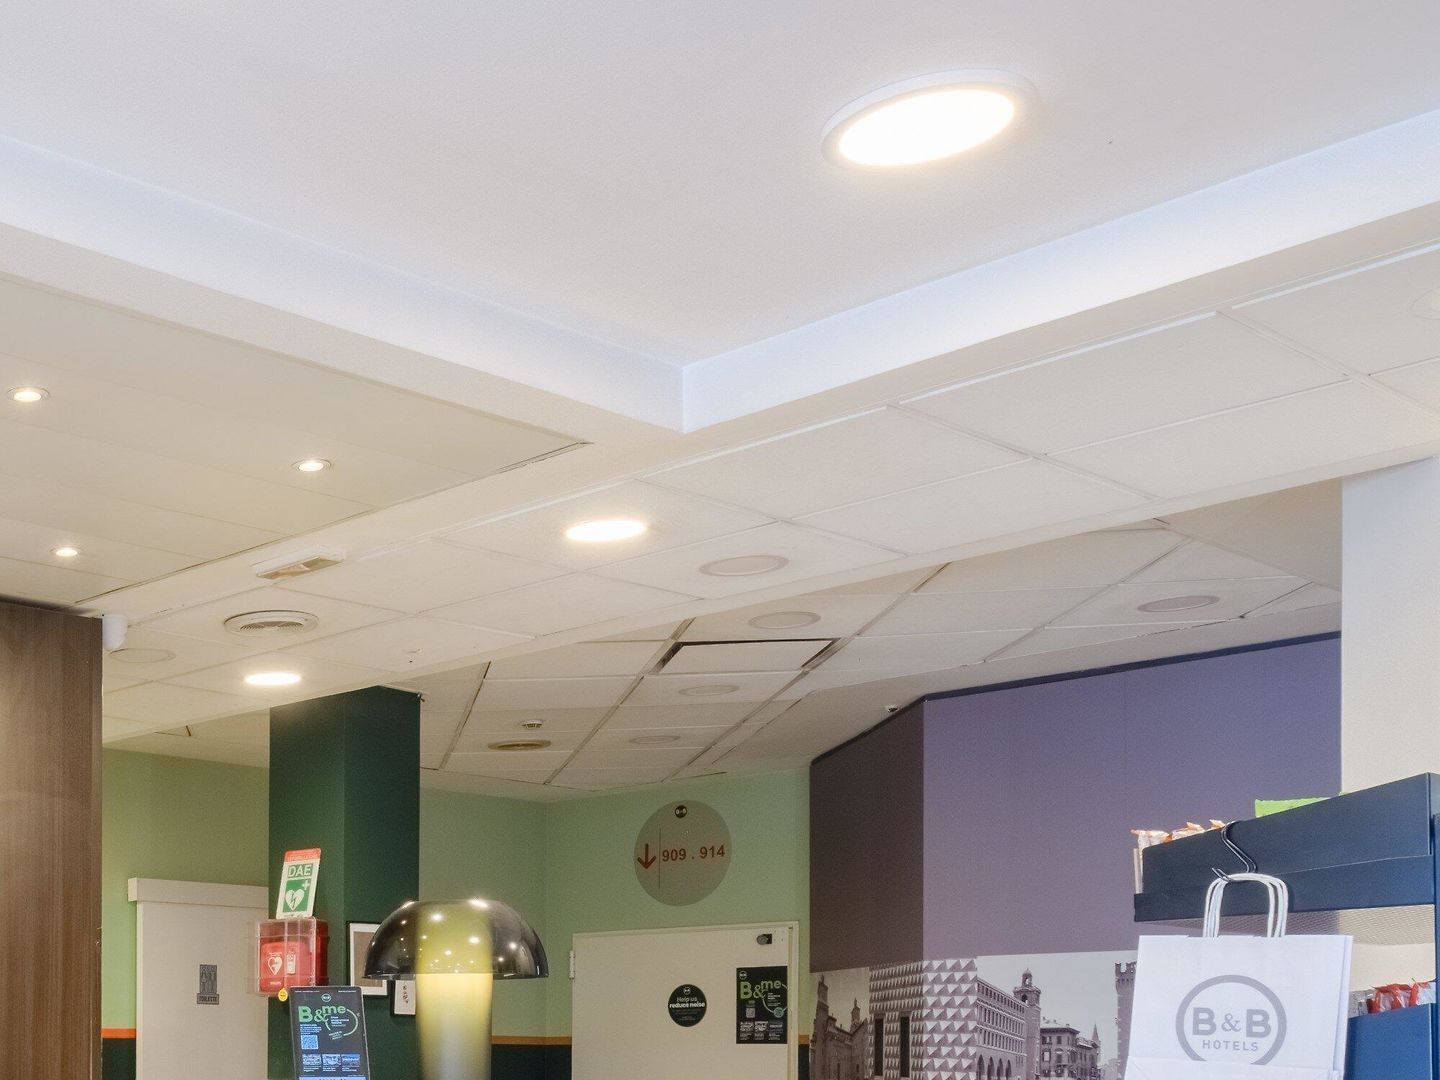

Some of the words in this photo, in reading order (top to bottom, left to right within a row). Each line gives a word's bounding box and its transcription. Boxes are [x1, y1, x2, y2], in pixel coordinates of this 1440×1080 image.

[661, 847, 687, 863] 909
[699, 844, 726, 859] 914
[288, 863, 312, 878] DAE
[298, 1005, 346, 1022] B&me
[1192, 1007, 1272, 1038] B&B
[1202, 1038, 1259, 1052] HOTELS
